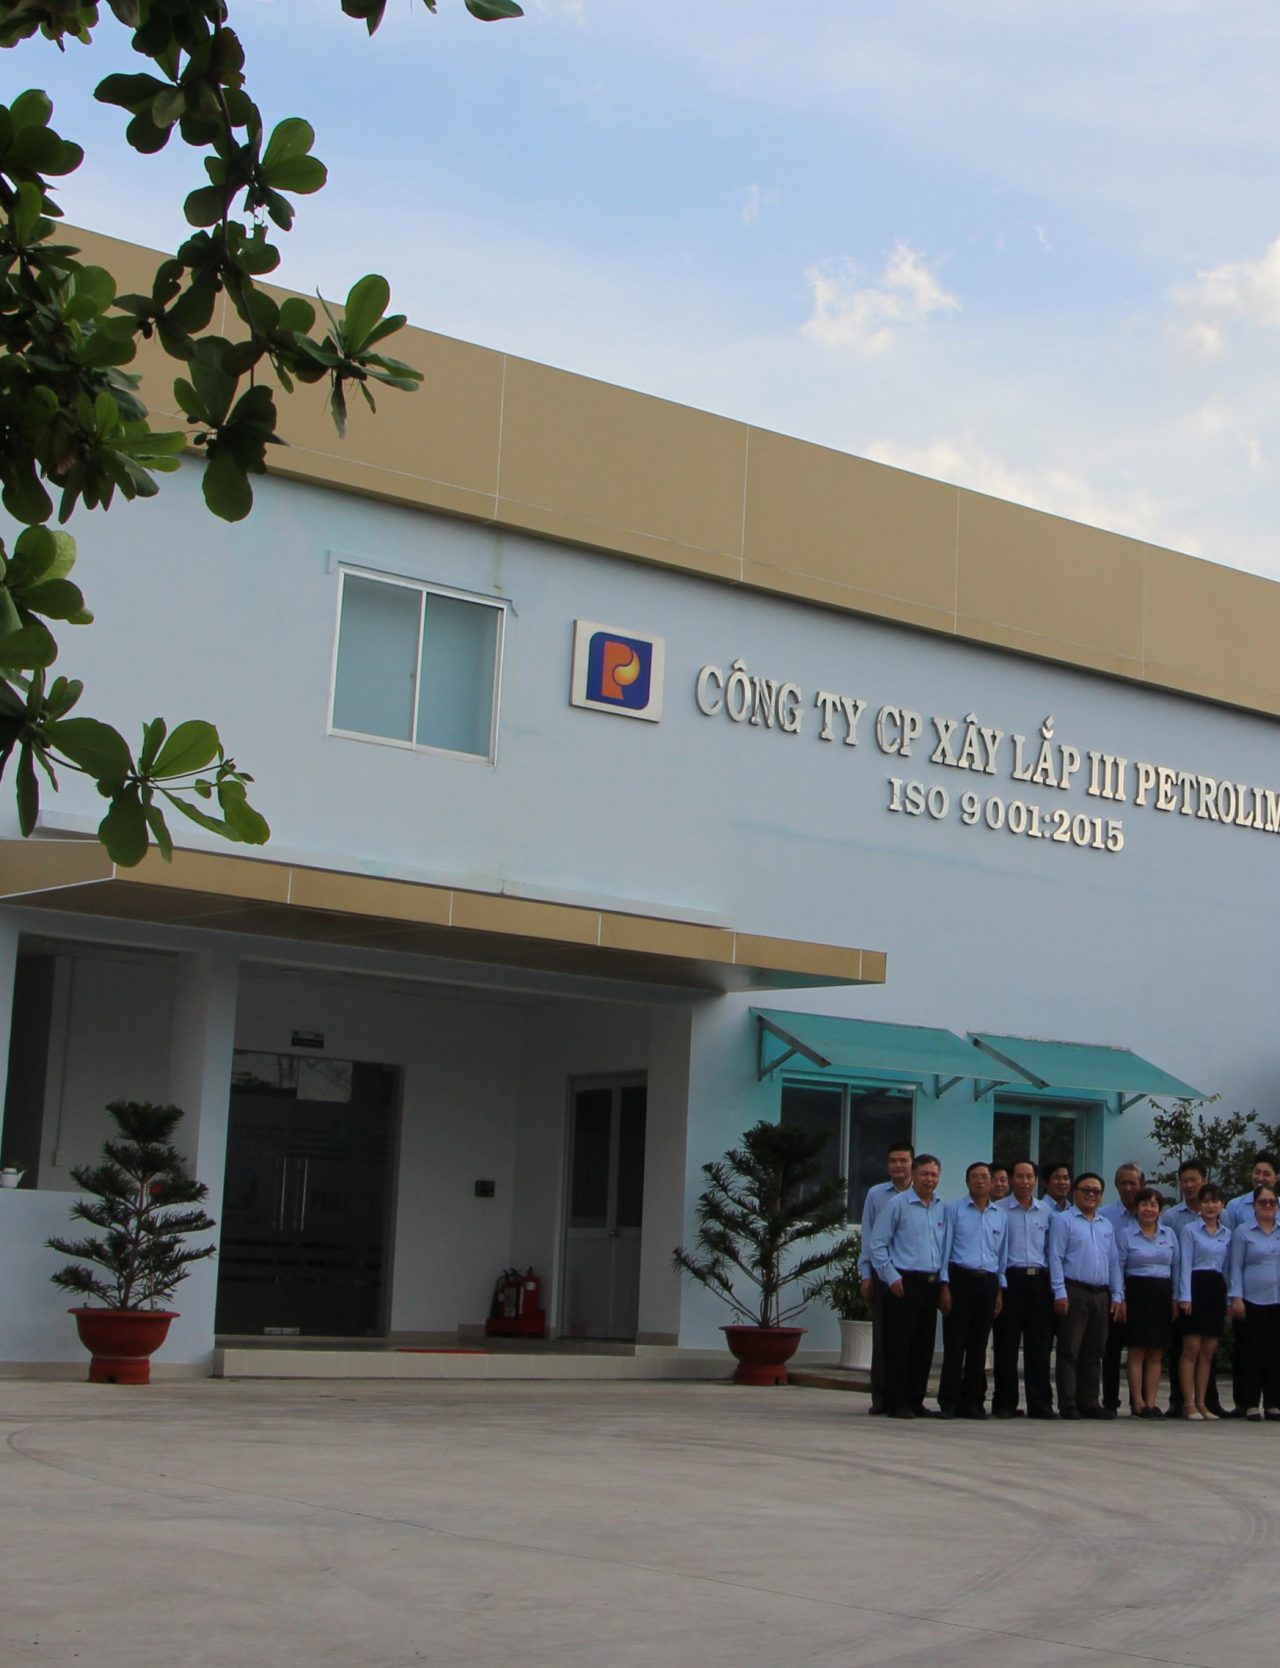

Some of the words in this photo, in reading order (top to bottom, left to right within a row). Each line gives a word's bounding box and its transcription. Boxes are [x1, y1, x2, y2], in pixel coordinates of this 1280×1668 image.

[695, 658, 805, 735] CÔNG
[814, 690, 867, 746] TY
[875, 704, 923, 757] CP
[929, 712, 1004, 775] XÂY
[1010, 715, 1081, 790] LẮP
[1087, 751, 1127, 801] III
[888, 777, 950, 820] ISO
[960, 791, 1125, 852] 9001:2015
